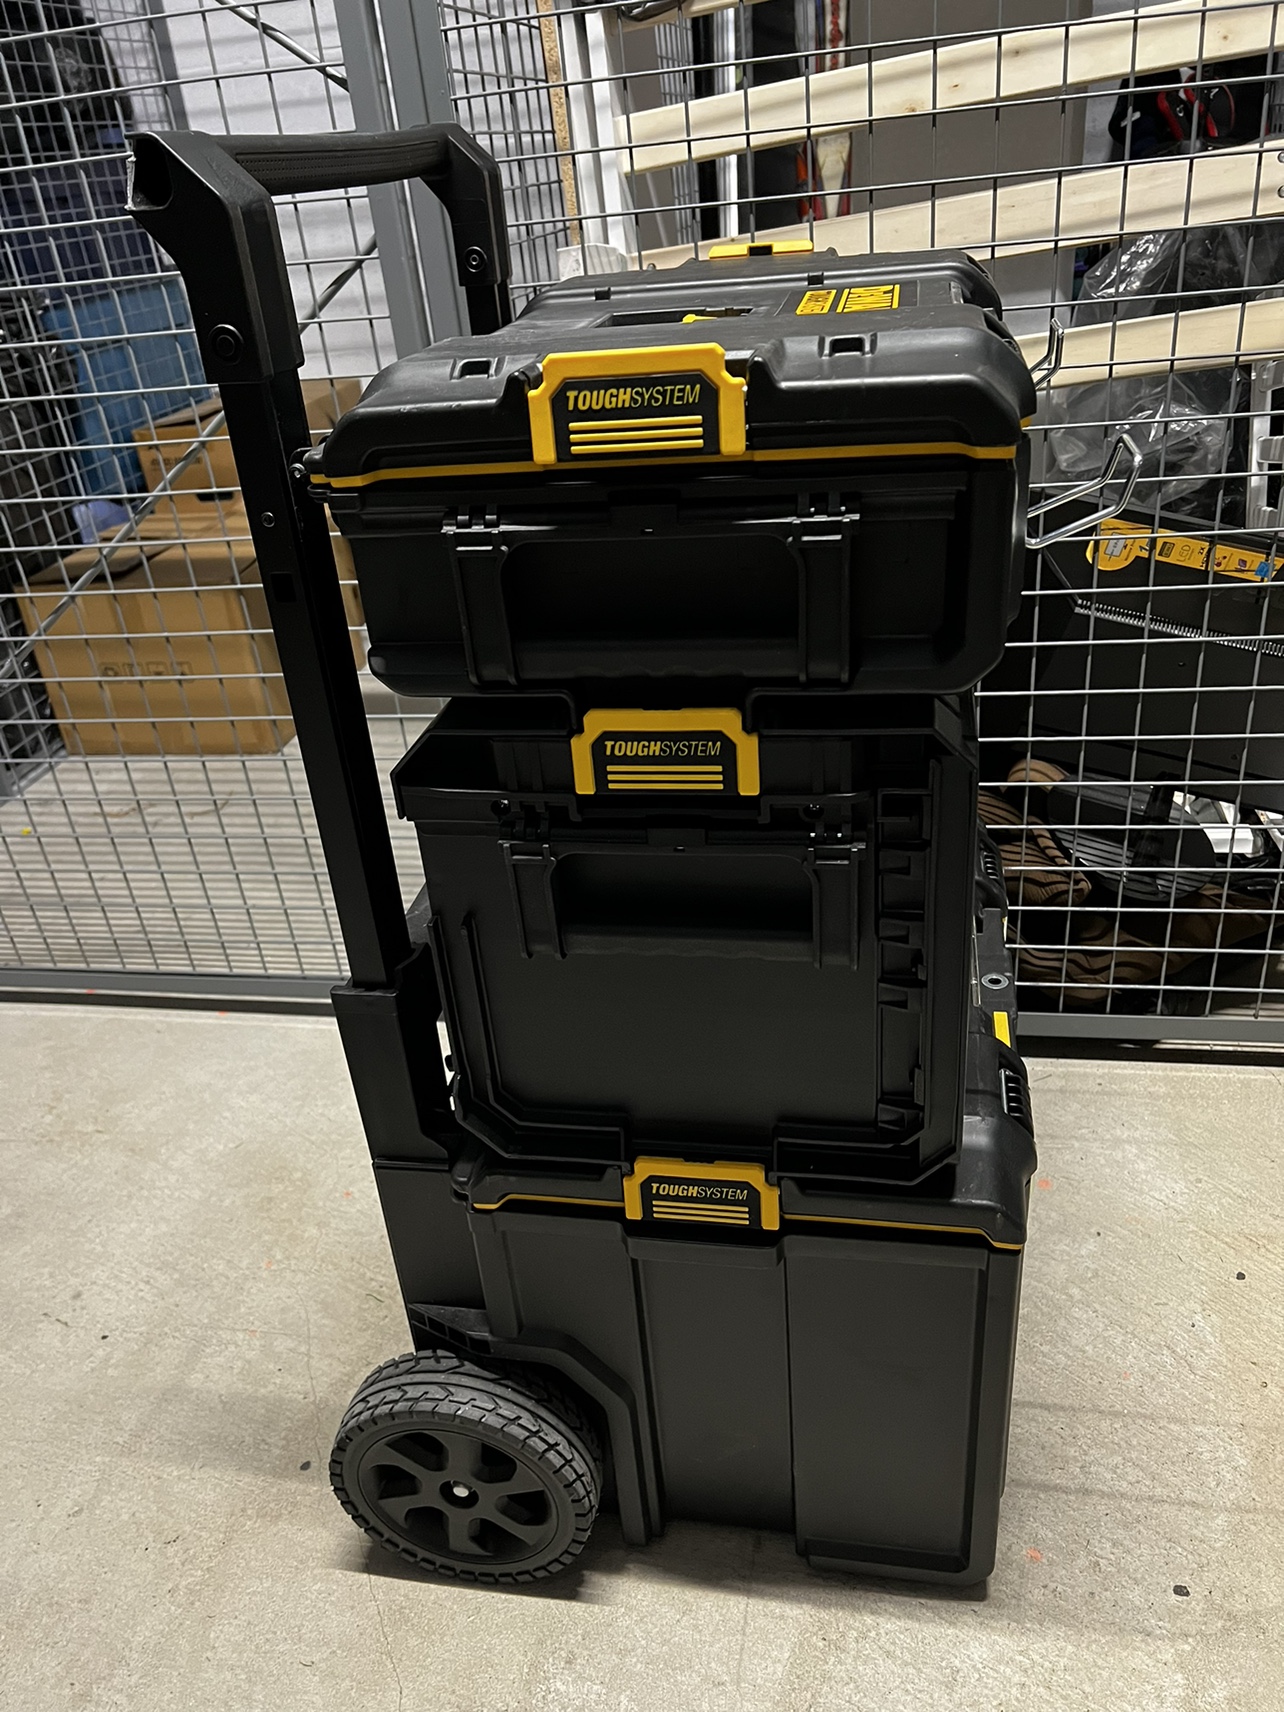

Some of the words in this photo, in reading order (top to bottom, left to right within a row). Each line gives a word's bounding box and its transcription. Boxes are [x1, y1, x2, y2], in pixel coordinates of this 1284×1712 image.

[566, 384, 701, 411] TOUGHSYSTEM
[1176, 544, 1191, 562] LED
[604, 741, 721, 757] TOUGHSYSTEM
[651, 1183, 748, 1200] TOUGHSYSTEM
